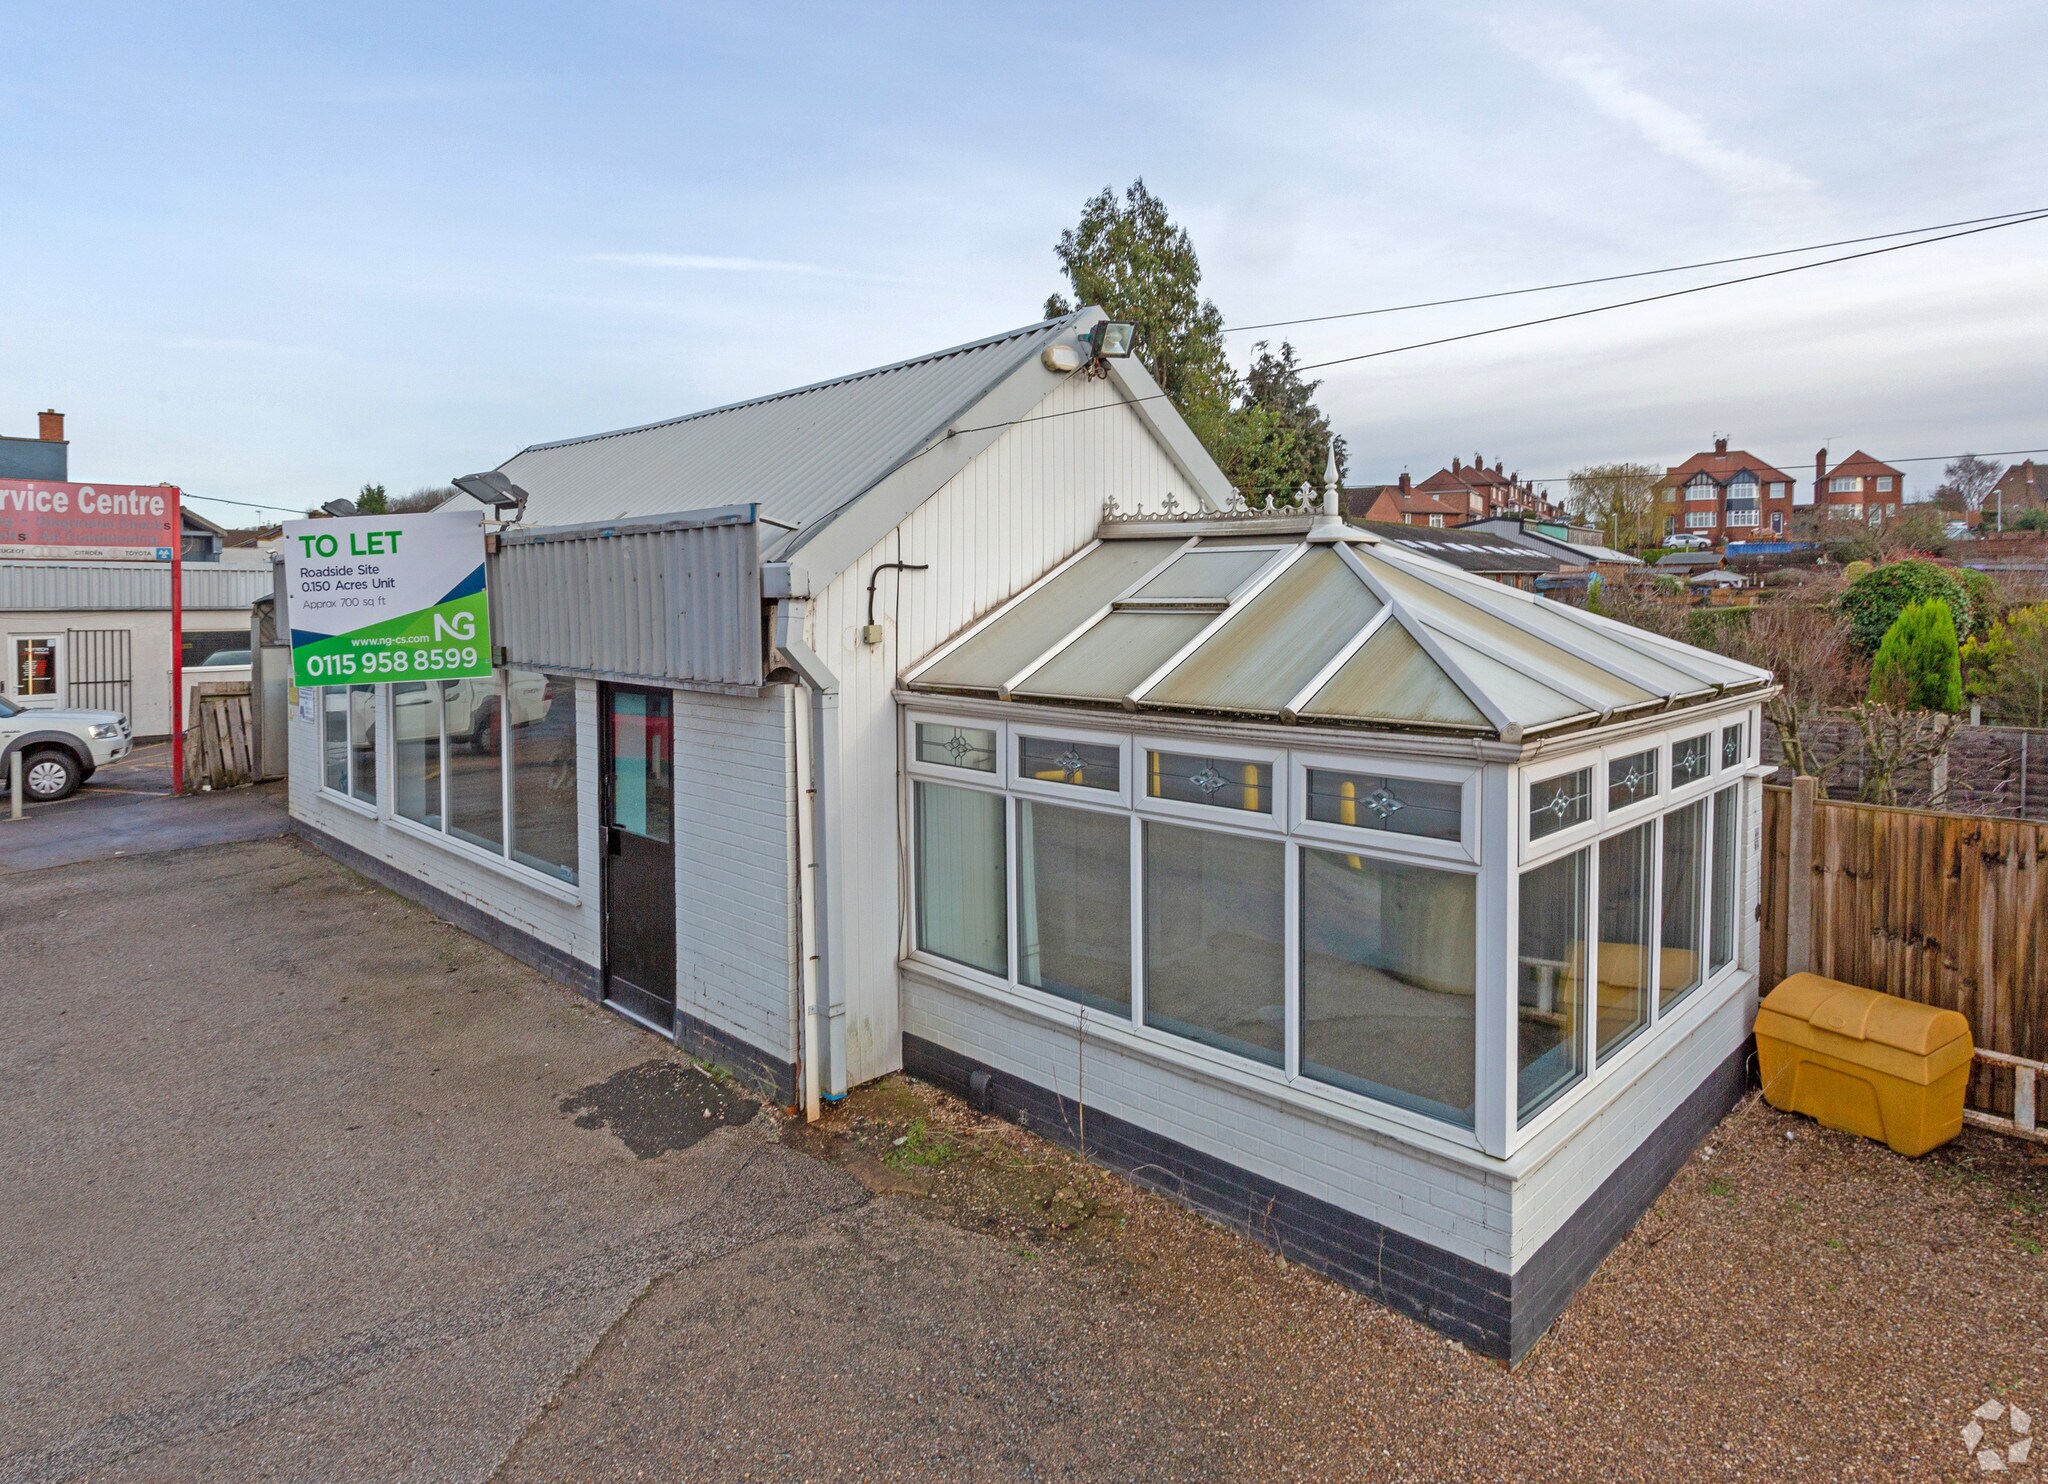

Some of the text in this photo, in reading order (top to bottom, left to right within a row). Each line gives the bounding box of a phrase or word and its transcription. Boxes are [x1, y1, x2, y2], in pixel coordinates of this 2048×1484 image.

[78, 486, 165, 516] Centre
[298, 531, 402, 558] TO LET
[300, 564, 379, 578] Roadside Site
[301, 577, 395, 592] 0.150 Acres Unit
[302, 596, 386, 610] Approx 700 sq ft
[433, 611, 475, 642] NG
[351, 635, 430, 647] www.ng-cs.com
[307, 647, 478, 677] 0115 958 8599
